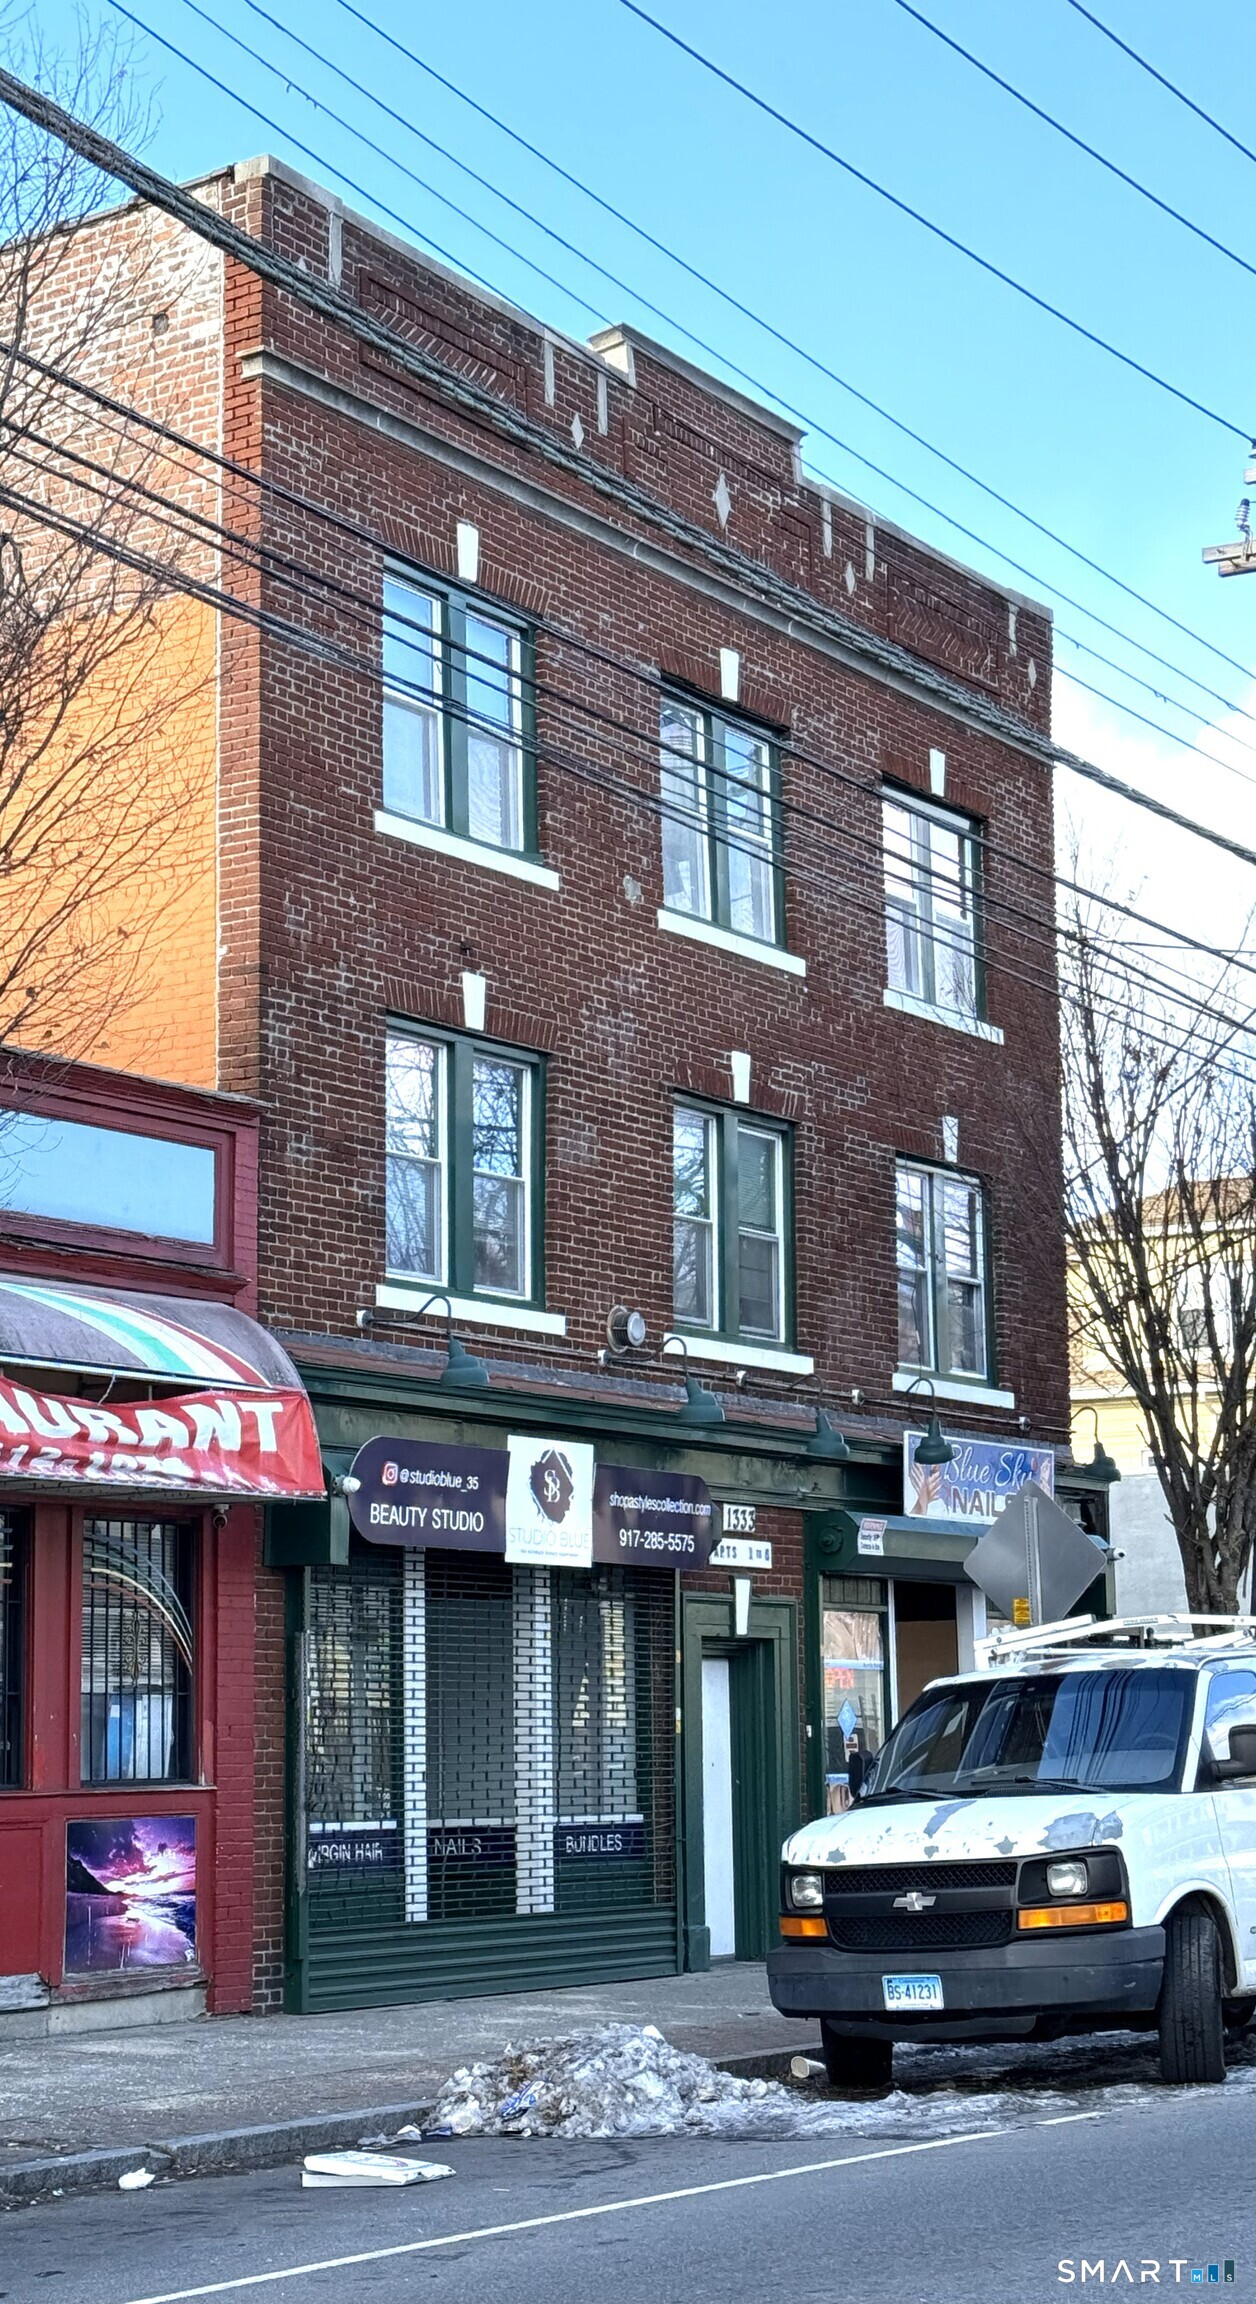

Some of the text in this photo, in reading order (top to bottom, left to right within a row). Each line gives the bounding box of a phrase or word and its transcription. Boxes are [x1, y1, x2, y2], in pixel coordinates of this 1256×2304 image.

[944, 1444, 1033, 1491] Blue Sky
[400, 1468, 480, 1493] @studioblue_35
[609, 1491, 712, 1517] shopastylescollection.com
[370, 1502, 484, 1533] BEAUTY STUDIO
[727, 1506, 755, 1531] 1333
[508, 1527, 590, 1549] STUDIO BLUE
[619, 1528, 695, 1553] 917-285-5575
[714, 1545, 737, 1559] APTS
[355, 1842, 383, 1861] HAIR
[434, 1838, 482, 1856] NAILS
[565, 1834, 623, 1853] BUNDLES
